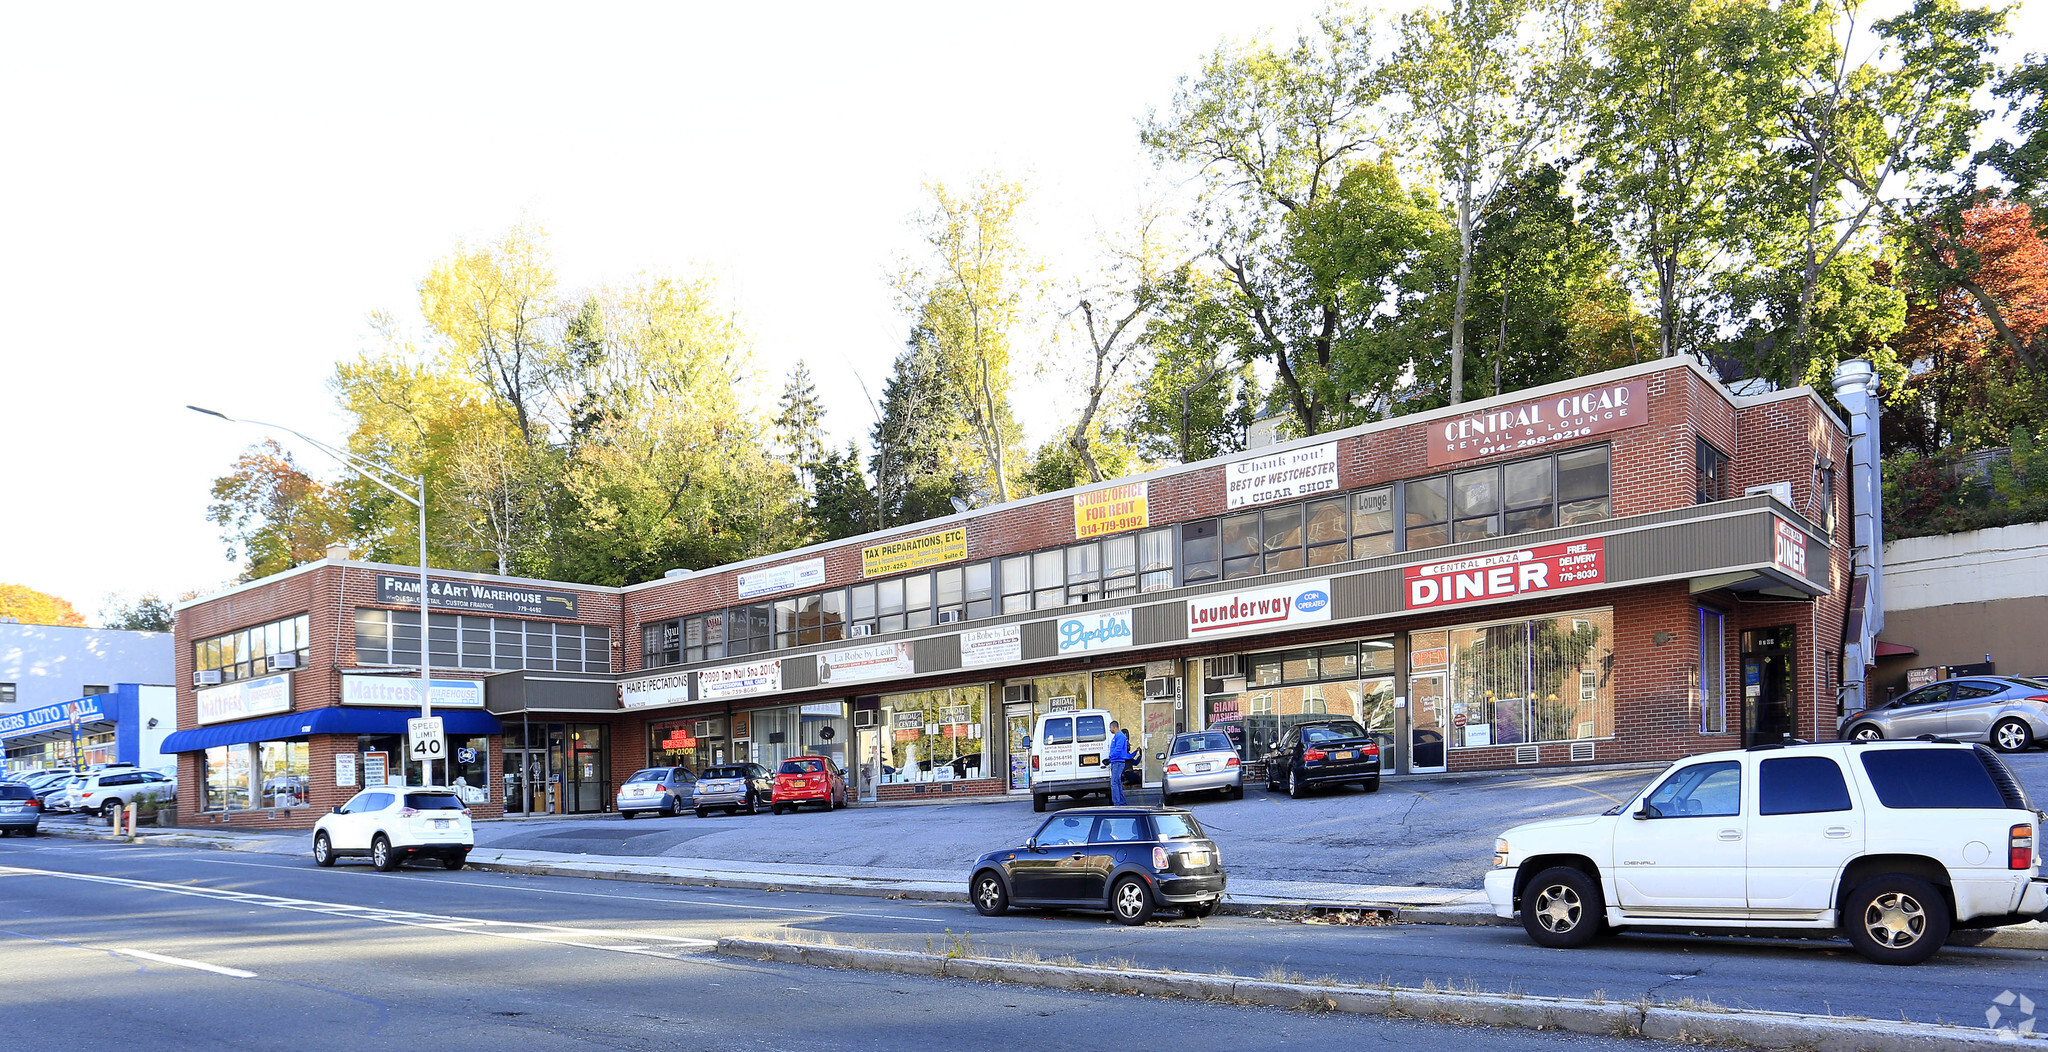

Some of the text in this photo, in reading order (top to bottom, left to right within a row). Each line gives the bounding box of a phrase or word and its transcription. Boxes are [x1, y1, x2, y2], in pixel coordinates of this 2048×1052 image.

[1445, 386, 1630, 441] CENTRAL CIGAR
[1447, 408, 1628, 452] RETAIL & LOUNGE
[1516, 427, 1591, 449] 268-0216
[1237, 456, 1287, 474] Thank
[1230, 461, 1336, 492] BEST OF WESTCHESTER
[1079, 482, 1143, 507] STORE/OFFICE
[1252, 487, 1293, 503] CIGAR
[1299, 479, 1334, 494] SHOP
[1086, 500, 1135, 521] FOR RENT
[1358, 494, 1388, 511] Lounge
[1081, 515, 1143, 536] 914-779-9192
[865, 531, 964, 559] TAX PREPARATIONS, ETC.
[1566, 543, 1588, 555] FREE
[944, 552, 958, 560] Suite
[1559, 553, 1597, 567] DELIVERY
[1777, 534, 1805, 574] DINER
[1433, 554, 1519, 574] CENTRAL PLAZA
[1411, 562, 1549, 606] DINER
[1559, 569, 1598, 582] 779-8030
[384, 577, 542, 604] FRAM & ART WAREHOUSE
[1303, 592, 1319, 600] COIN
[445, 599, 469, 608] CUSTOM
[470, 601, 494, 609] FRAMING
[1191, 596, 1292, 624] Launderway
[1297, 600, 1326, 609] OPERATED
[977, 630, 993, 641] Robe
[1002, 625, 1019, 637] Leah
[834, 646, 893, 662] La Robe by Leah
[1412, 650, 1447, 667] OPEN
[705, 671, 720, 683] 9999
[734, 667, 746, 680] Nail
[747, 666, 758, 678] Spa
[349, 681, 476, 701] Mattress WAREHOUSE
[626, 683, 641, 695] HAIR
[1052, 697, 1074, 706] BRIDAL
[1213, 700, 1238, 712] GIANT
[28, 706, 60, 726] AUTO
[898, 719, 918, 727] CENTER
[1209, 711, 1243, 722] WASHERS
[412, 722, 440, 730] SPEED
[1227, 725, 1235, 733] 50
[416, 731, 437, 739] LIMIT
[414, 739, 441, 755] 40
